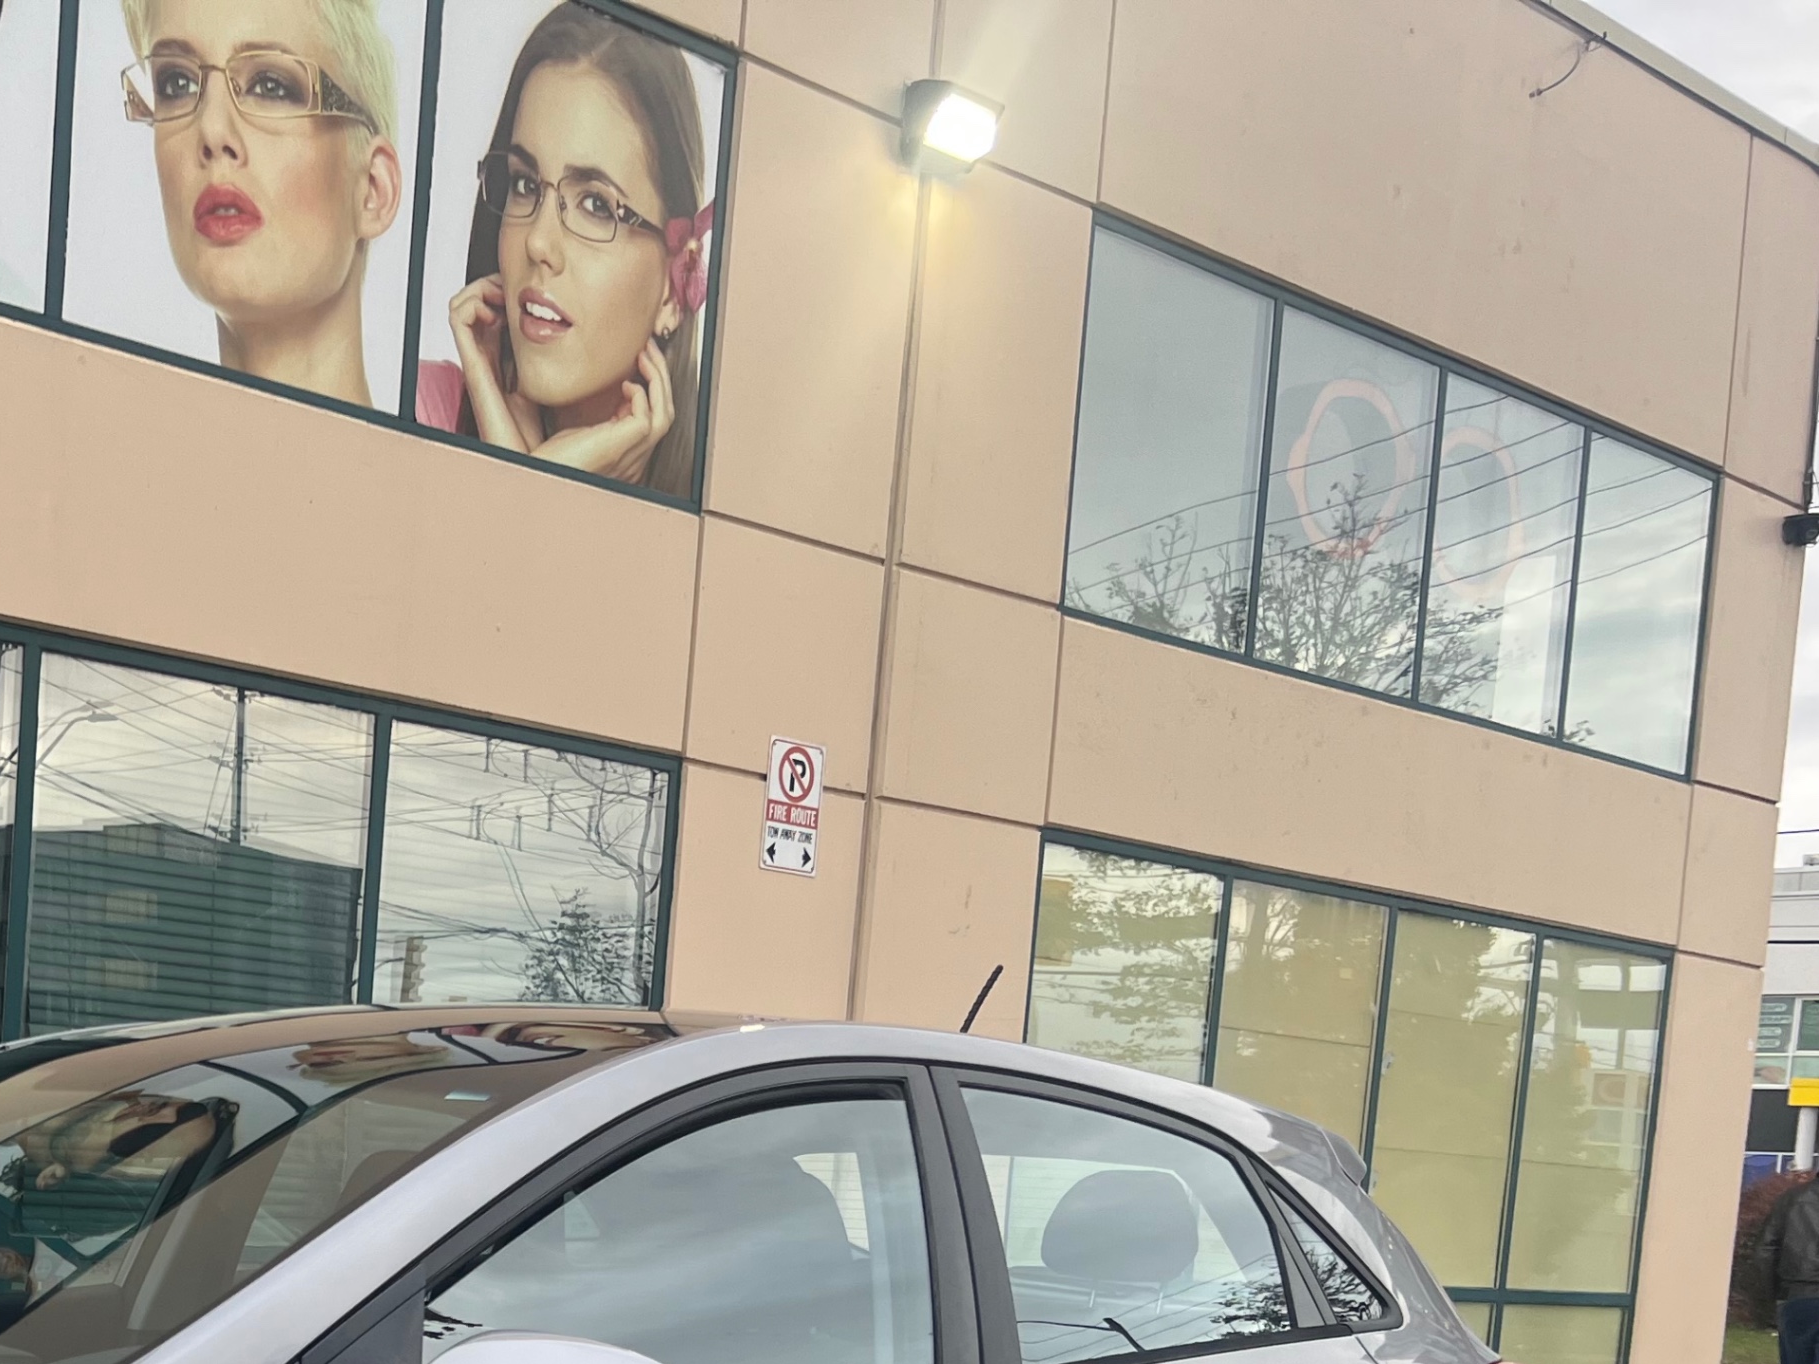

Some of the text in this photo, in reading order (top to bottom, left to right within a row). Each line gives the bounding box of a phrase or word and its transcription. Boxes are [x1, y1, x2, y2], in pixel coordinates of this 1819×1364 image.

[769, 803, 817, 827] FIRE ROUTE
[767, 825, 813, 844] TOW AWAY ZONE
